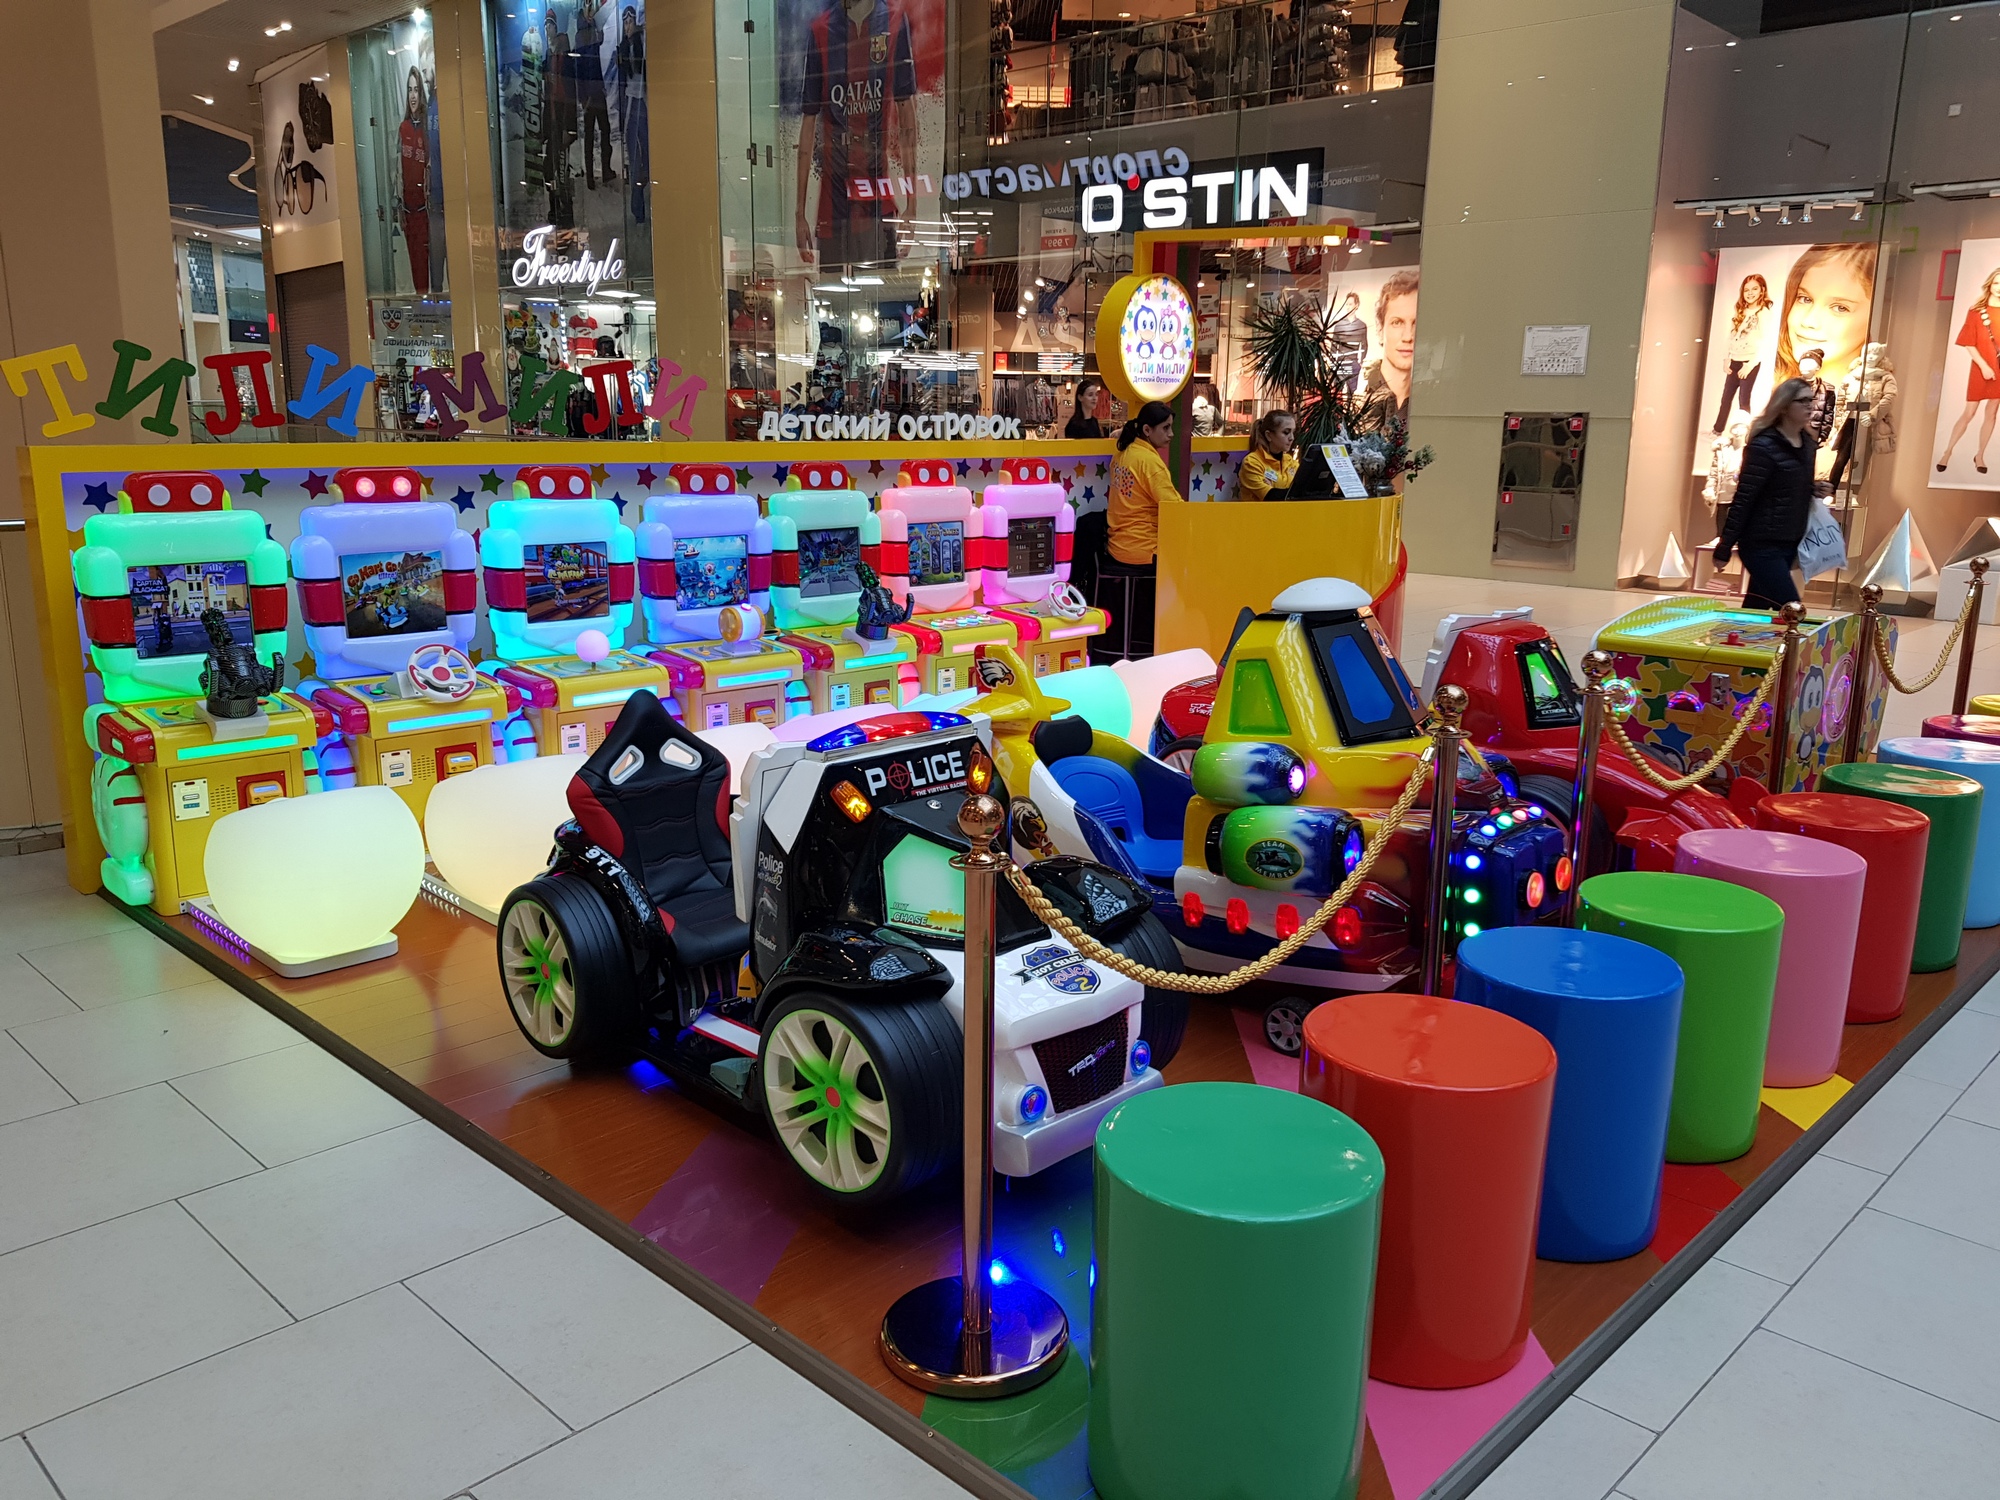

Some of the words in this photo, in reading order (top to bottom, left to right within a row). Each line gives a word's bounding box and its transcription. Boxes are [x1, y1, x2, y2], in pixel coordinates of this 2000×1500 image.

[831, 79, 882, 107] QATAR
[843, 99, 881, 116] AIRWAYS
[512, 225, 623, 297] Freestyle
[383, 339, 447, 347] ОФИЦИАЛЬНАЯ
[0, 339, 376, 438] ТИЛИ
[416, 351, 707, 438] МИЛИ
[915, 789, 928, 797] THE
[927, 784, 950, 795] VIRTUAL
[1261, 841, 1286, 850] TEAM
[758, 851, 784, 875] Police
[1254, 866, 1295, 879] MEMBER
[892, 911, 928, 926] CHASE
[1032, 964, 1052, 978] HOT
[1050, 965, 1093, 987] POLICE
[1074, 976, 1094, 991] 2
